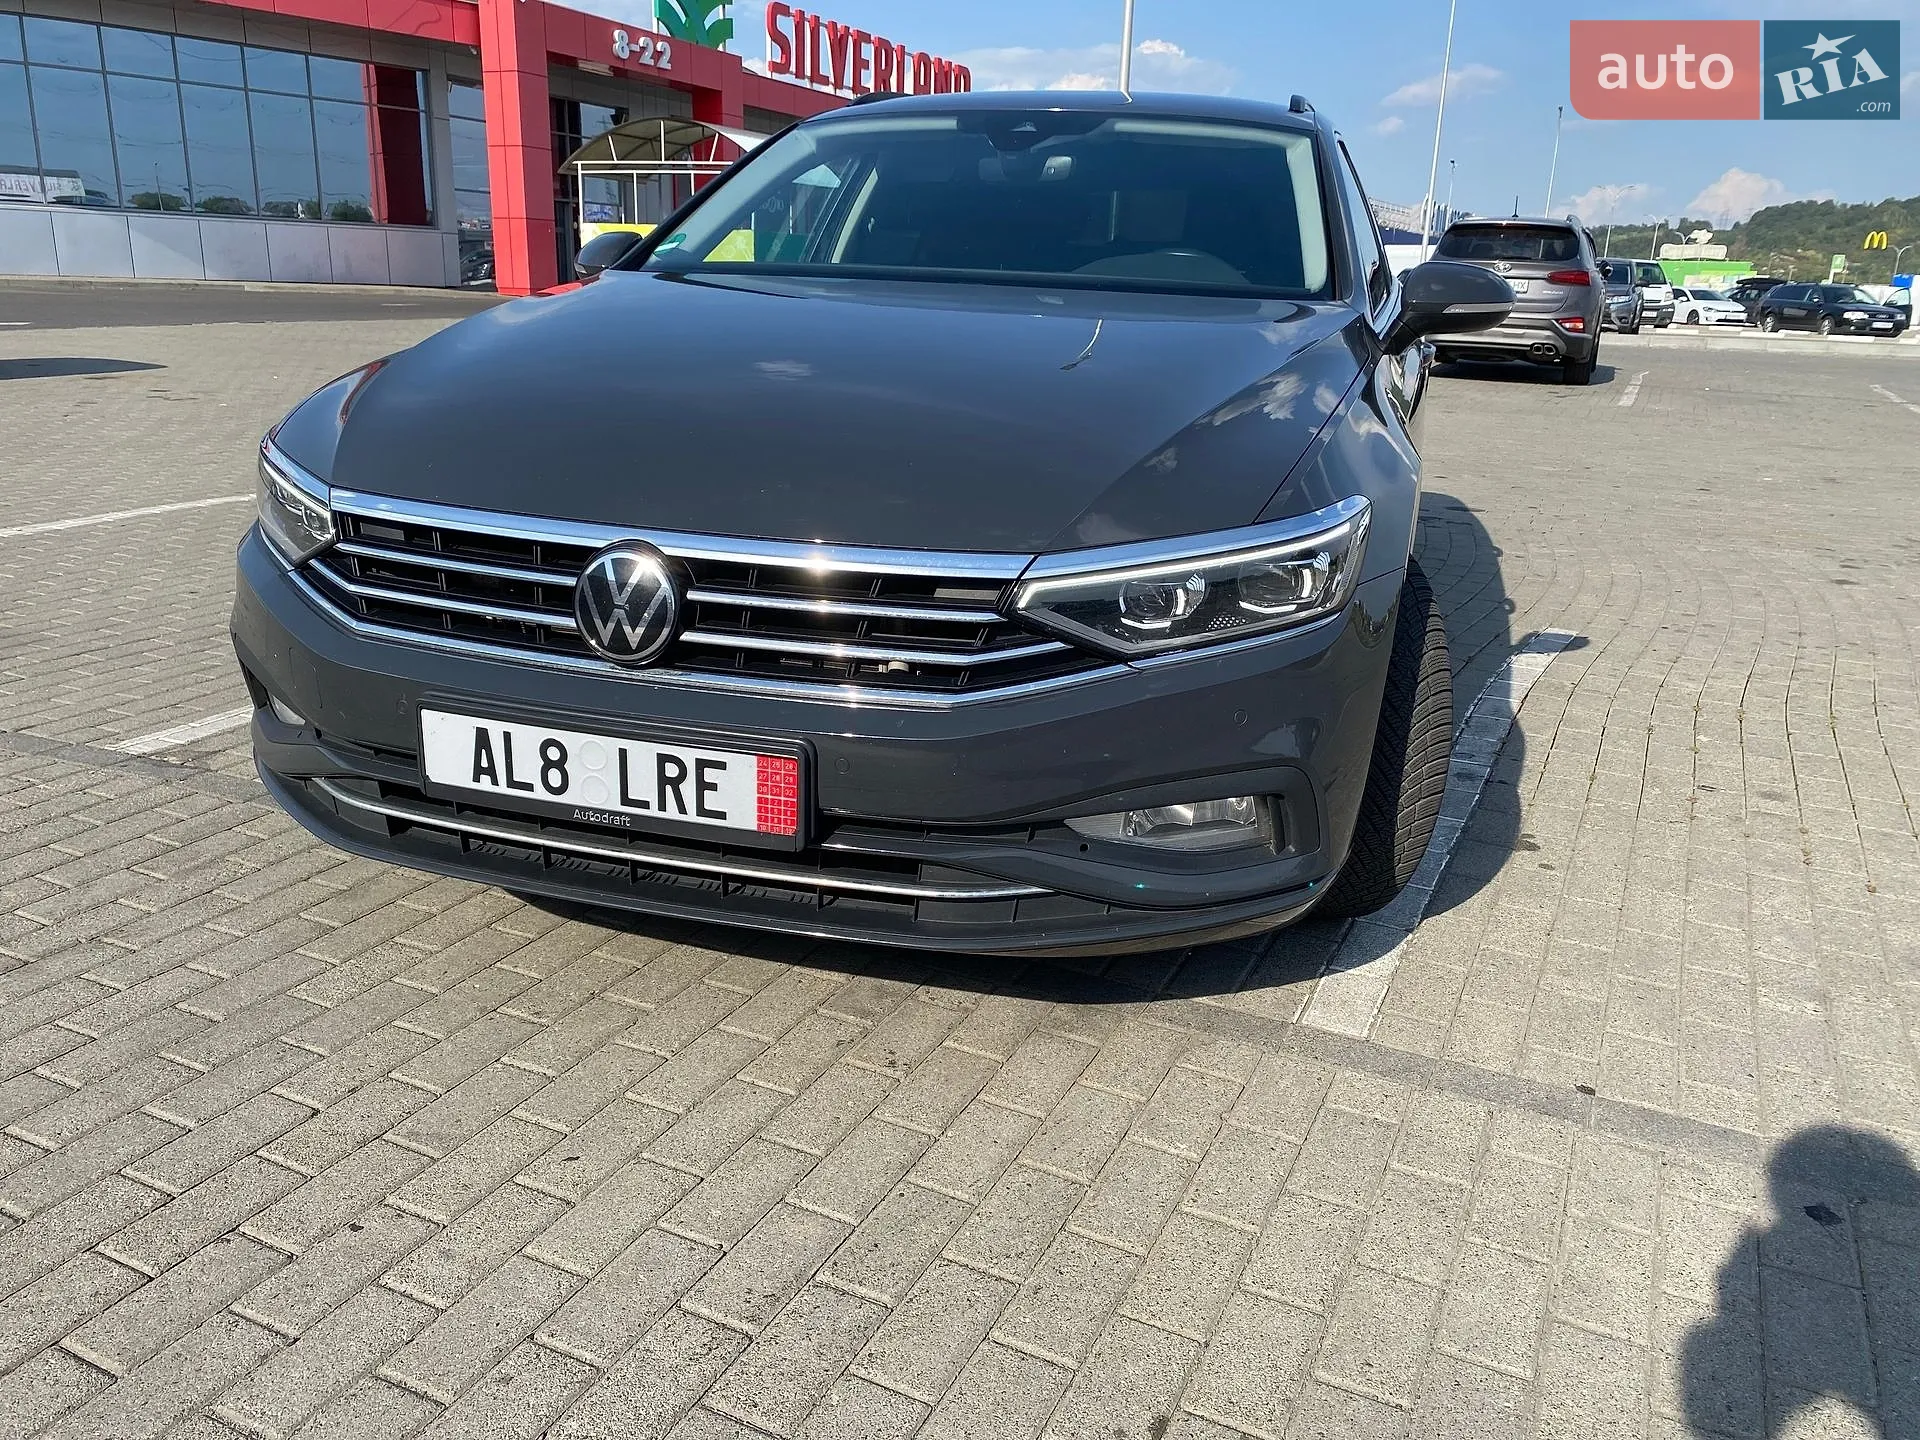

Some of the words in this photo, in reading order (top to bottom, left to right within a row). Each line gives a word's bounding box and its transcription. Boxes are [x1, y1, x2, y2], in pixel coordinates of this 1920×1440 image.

[612, 29, 673, 71] 8-22
[766, 1, 972, 95] SILVERLAND
[472, 726, 569, 796] AL8
[618, 748, 727, 821] LRE
[573, 808, 631, 827] Autodraft
